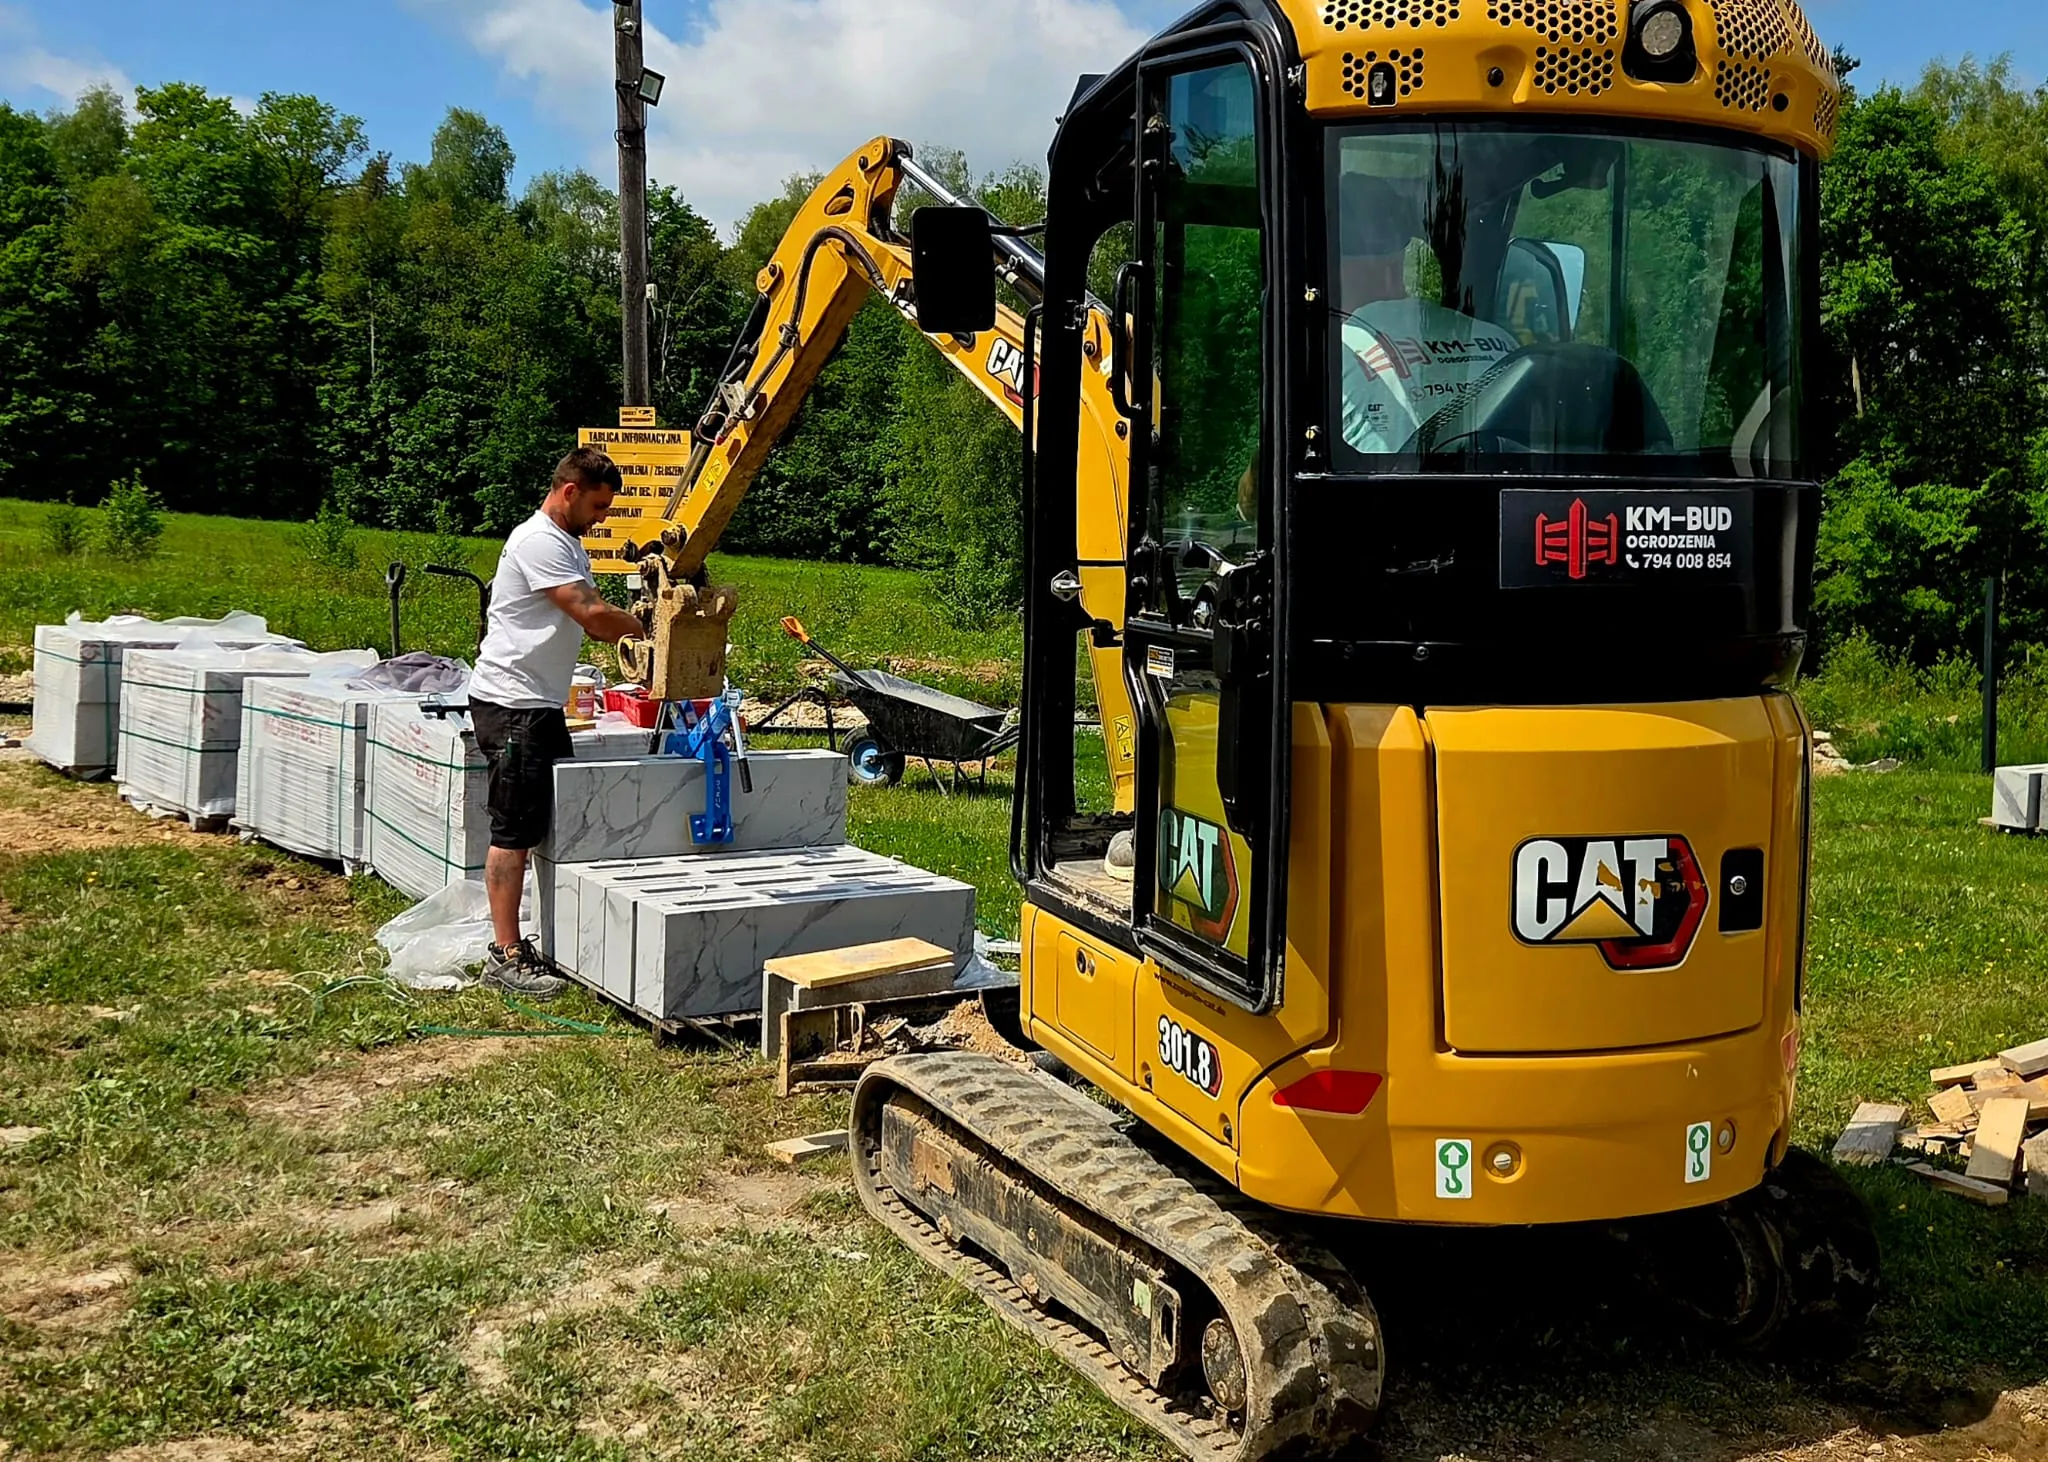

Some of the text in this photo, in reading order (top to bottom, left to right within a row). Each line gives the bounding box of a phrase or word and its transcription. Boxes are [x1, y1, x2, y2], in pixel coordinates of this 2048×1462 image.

[1424, 382, 1454, 396] 794
[589, 431, 682, 444] TABLICA INFORMACYJNA
[1625, 506, 1732, 531] KM-BUD
[1626, 535, 1716, 549] OGRODZENIA
[1643, 552, 1732, 569] 794 008 854
[1160, 808, 1218, 912] CAT
[1516, 838, 1667, 940] CAT
[1159, 1016, 1211, 1089] 301.8
